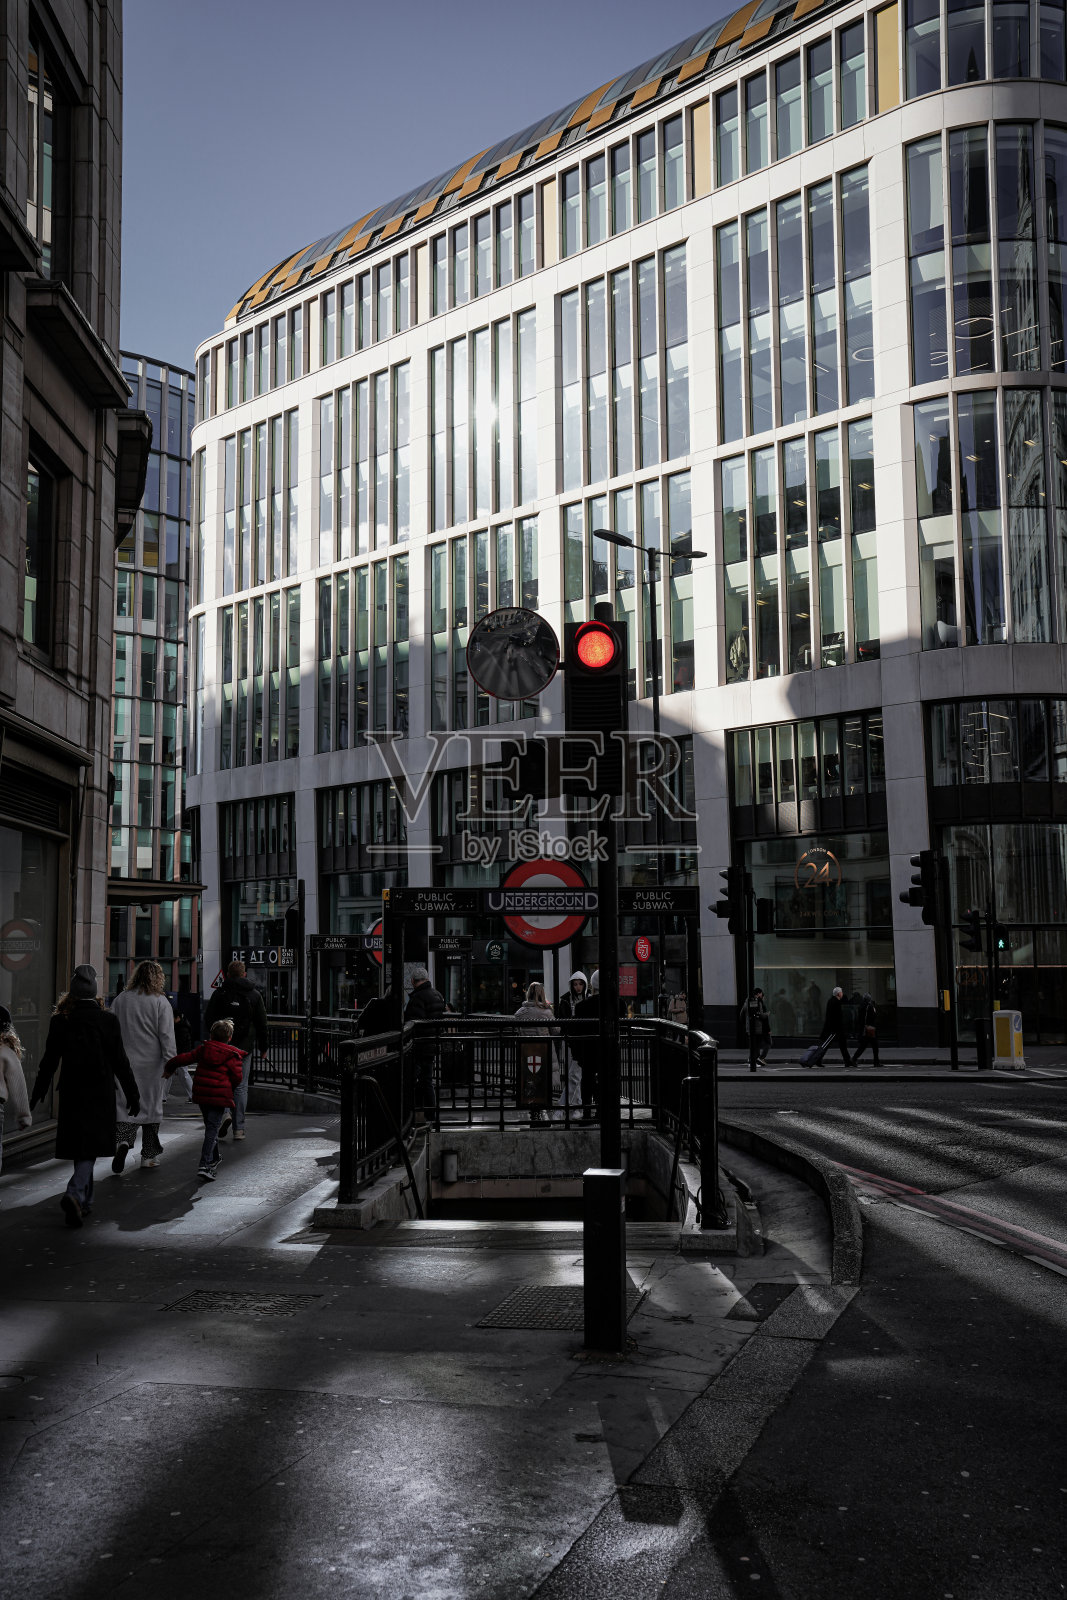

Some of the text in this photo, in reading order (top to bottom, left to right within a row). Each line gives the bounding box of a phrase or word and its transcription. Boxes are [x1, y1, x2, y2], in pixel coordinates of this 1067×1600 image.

[803, 861, 833, 888] 24
[417, 892, 454, 902] PUBLIC
[635, 891, 672, 900] PUBLIC
[488, 892, 599, 911] UNDERGROUND
[632, 901, 675, 910] SUBWAY
[414, 902, 456, 911] SUBWAY
